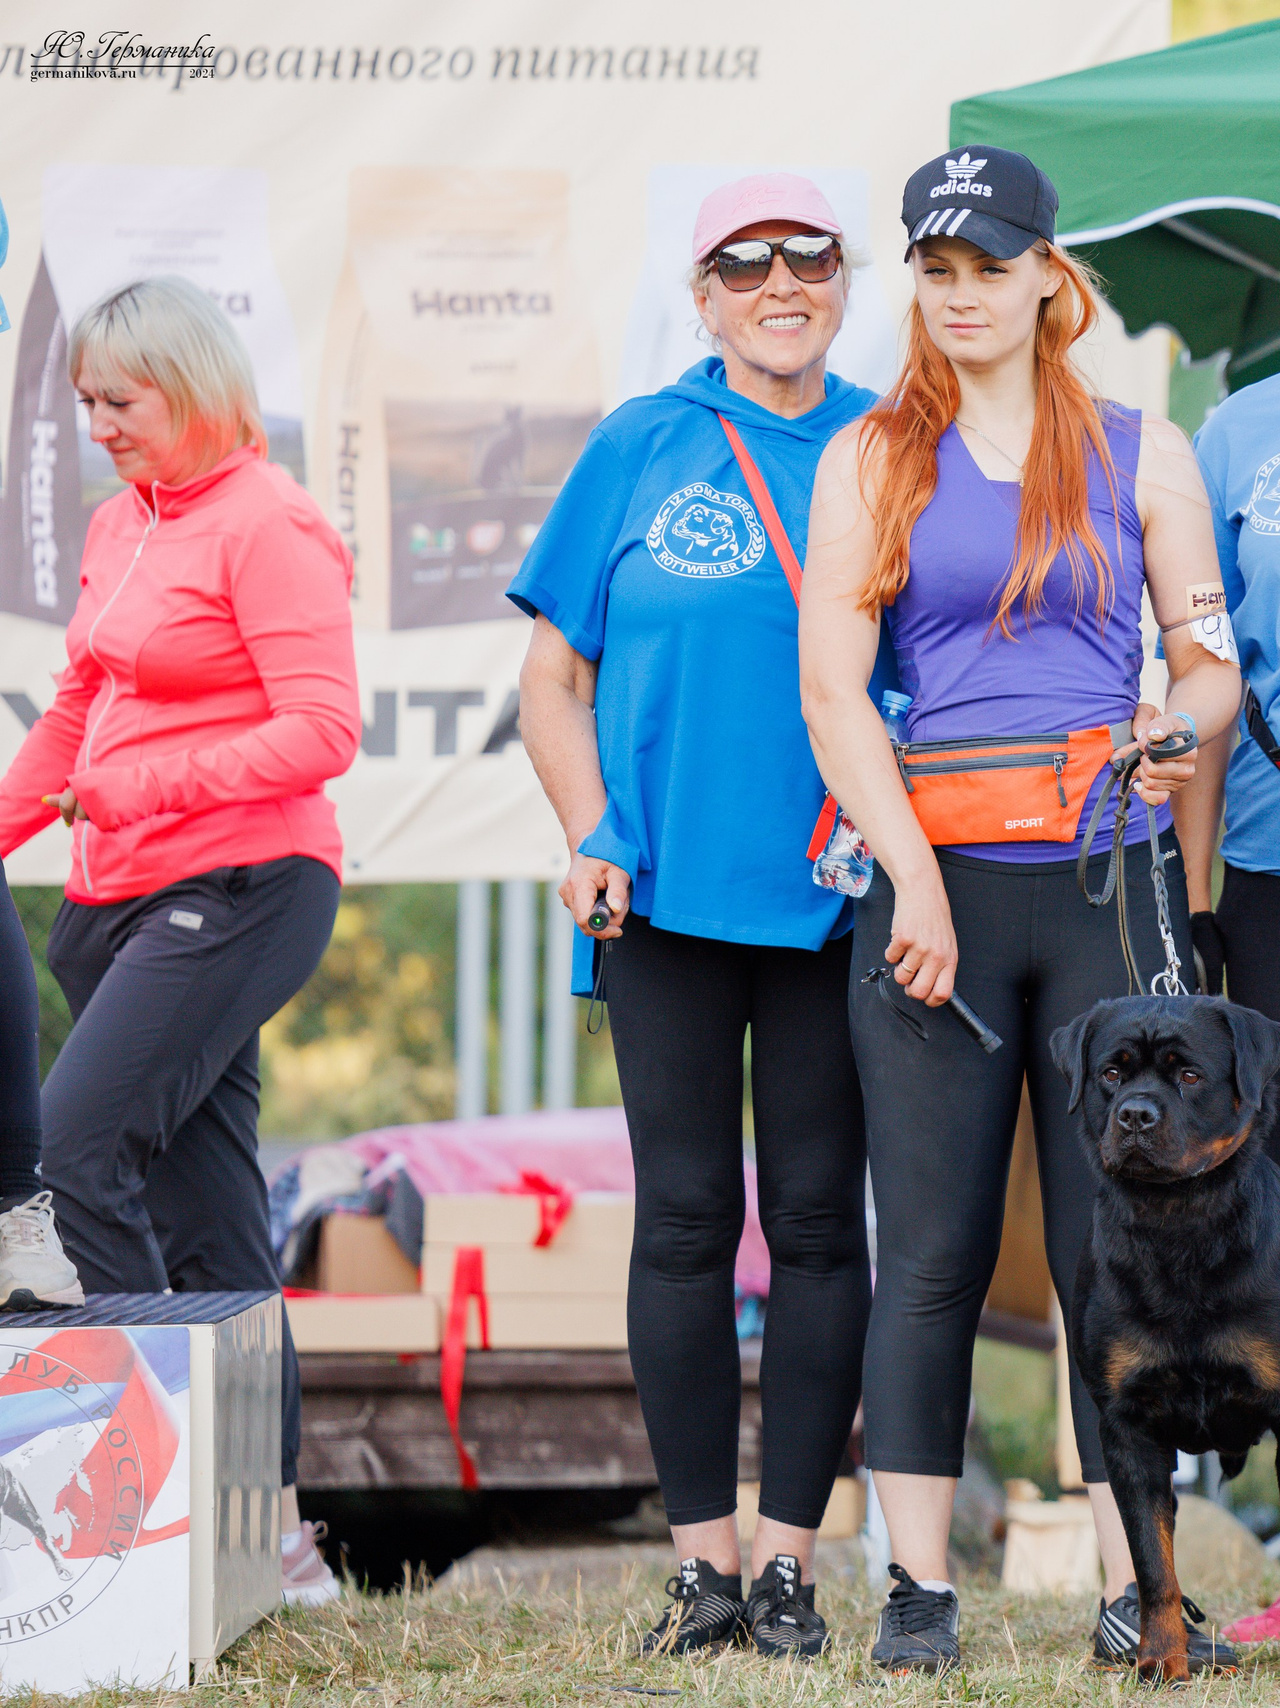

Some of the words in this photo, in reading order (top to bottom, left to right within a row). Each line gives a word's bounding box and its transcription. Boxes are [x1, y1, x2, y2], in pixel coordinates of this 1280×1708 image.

[491, 43, 760, 80] питания
[930, 179, 992, 198] adidas
[412, 288, 552, 317] Hanta
[31, 419, 59, 608] Hanta
[684, 484, 721, 502] DOMA
[725, 495, 757, 528] TORRA
[657, 550, 740, 576] ROTTWEILER
[1004, 817, 1045, 830] SPORT
[91, 1403, 140, 1562] РОССИИ
